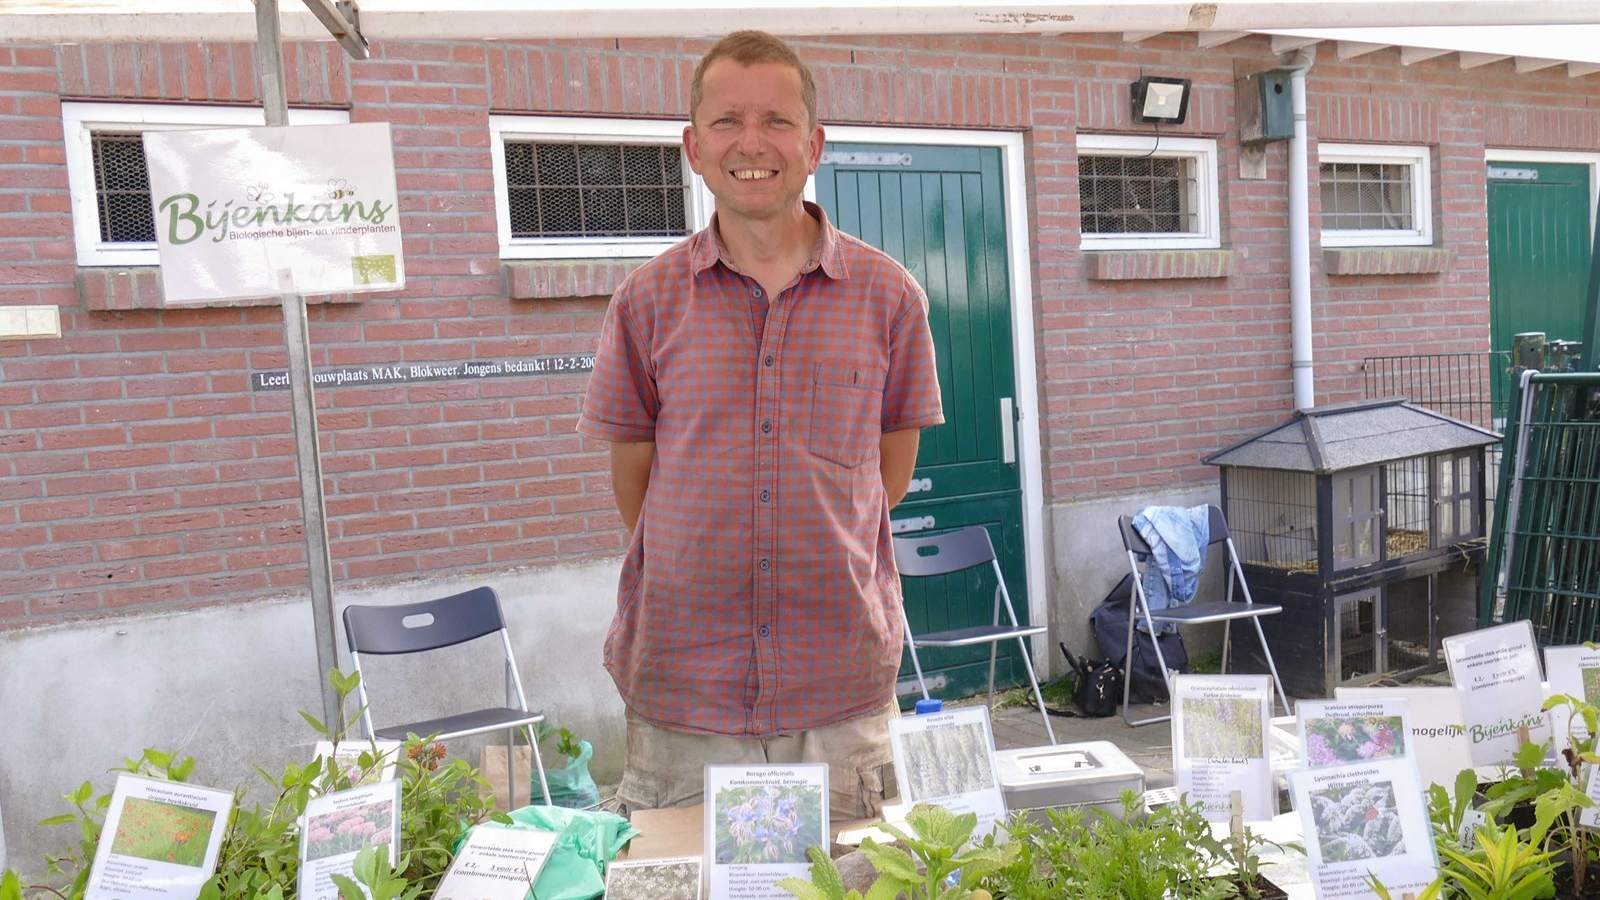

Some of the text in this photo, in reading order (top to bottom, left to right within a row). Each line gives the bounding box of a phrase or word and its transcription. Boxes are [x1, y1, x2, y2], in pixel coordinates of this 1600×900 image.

[159, 192, 393, 245] Bijenkans
[229, 228, 284, 241] Biologische
[410, 364, 460, 378] Blokweer.
[463, 363, 501, 377] Jongens
[554, 356, 597, 370] 12-2-200
[1469, 715, 1544, 744] Bijenkans
